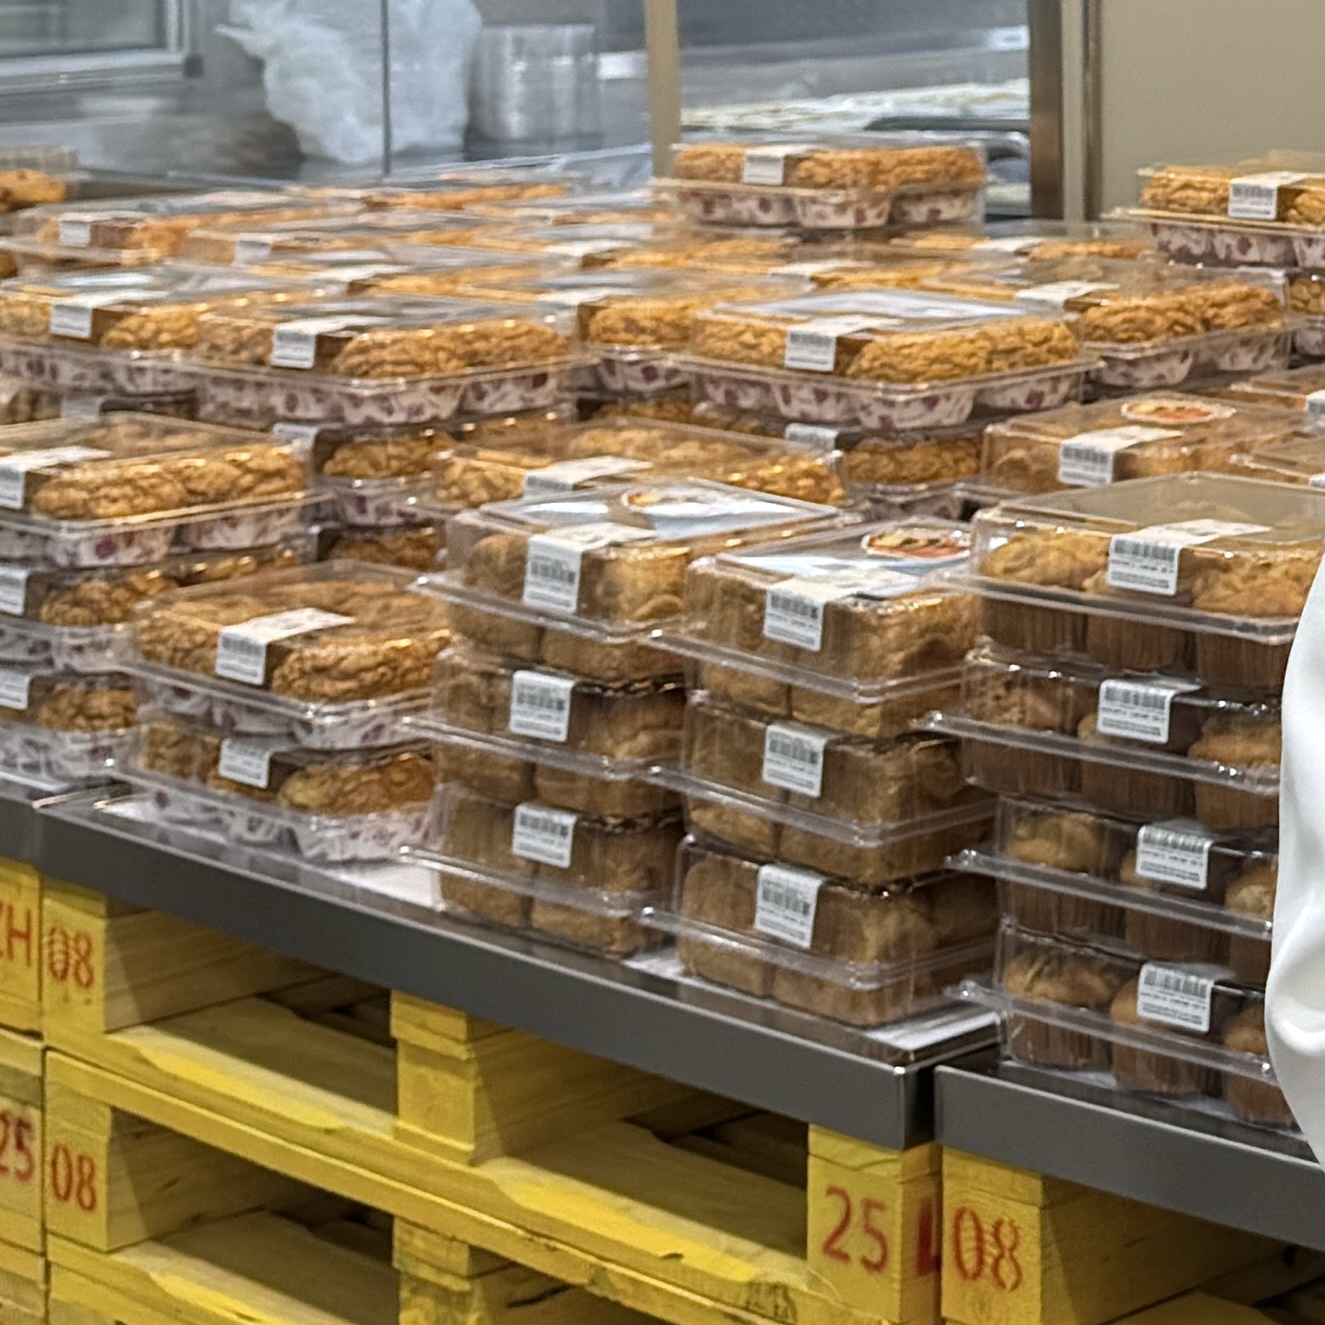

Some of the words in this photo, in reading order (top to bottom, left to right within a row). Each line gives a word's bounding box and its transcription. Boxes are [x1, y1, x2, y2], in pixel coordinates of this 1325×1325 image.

[0, 899, 32, 968] H
[50, 927, 94, 989] 08
[51, 1143, 97, 1212] 08
[822, 1185, 889, 1274] 25
[953, 1206, 1022, 1292] 08
